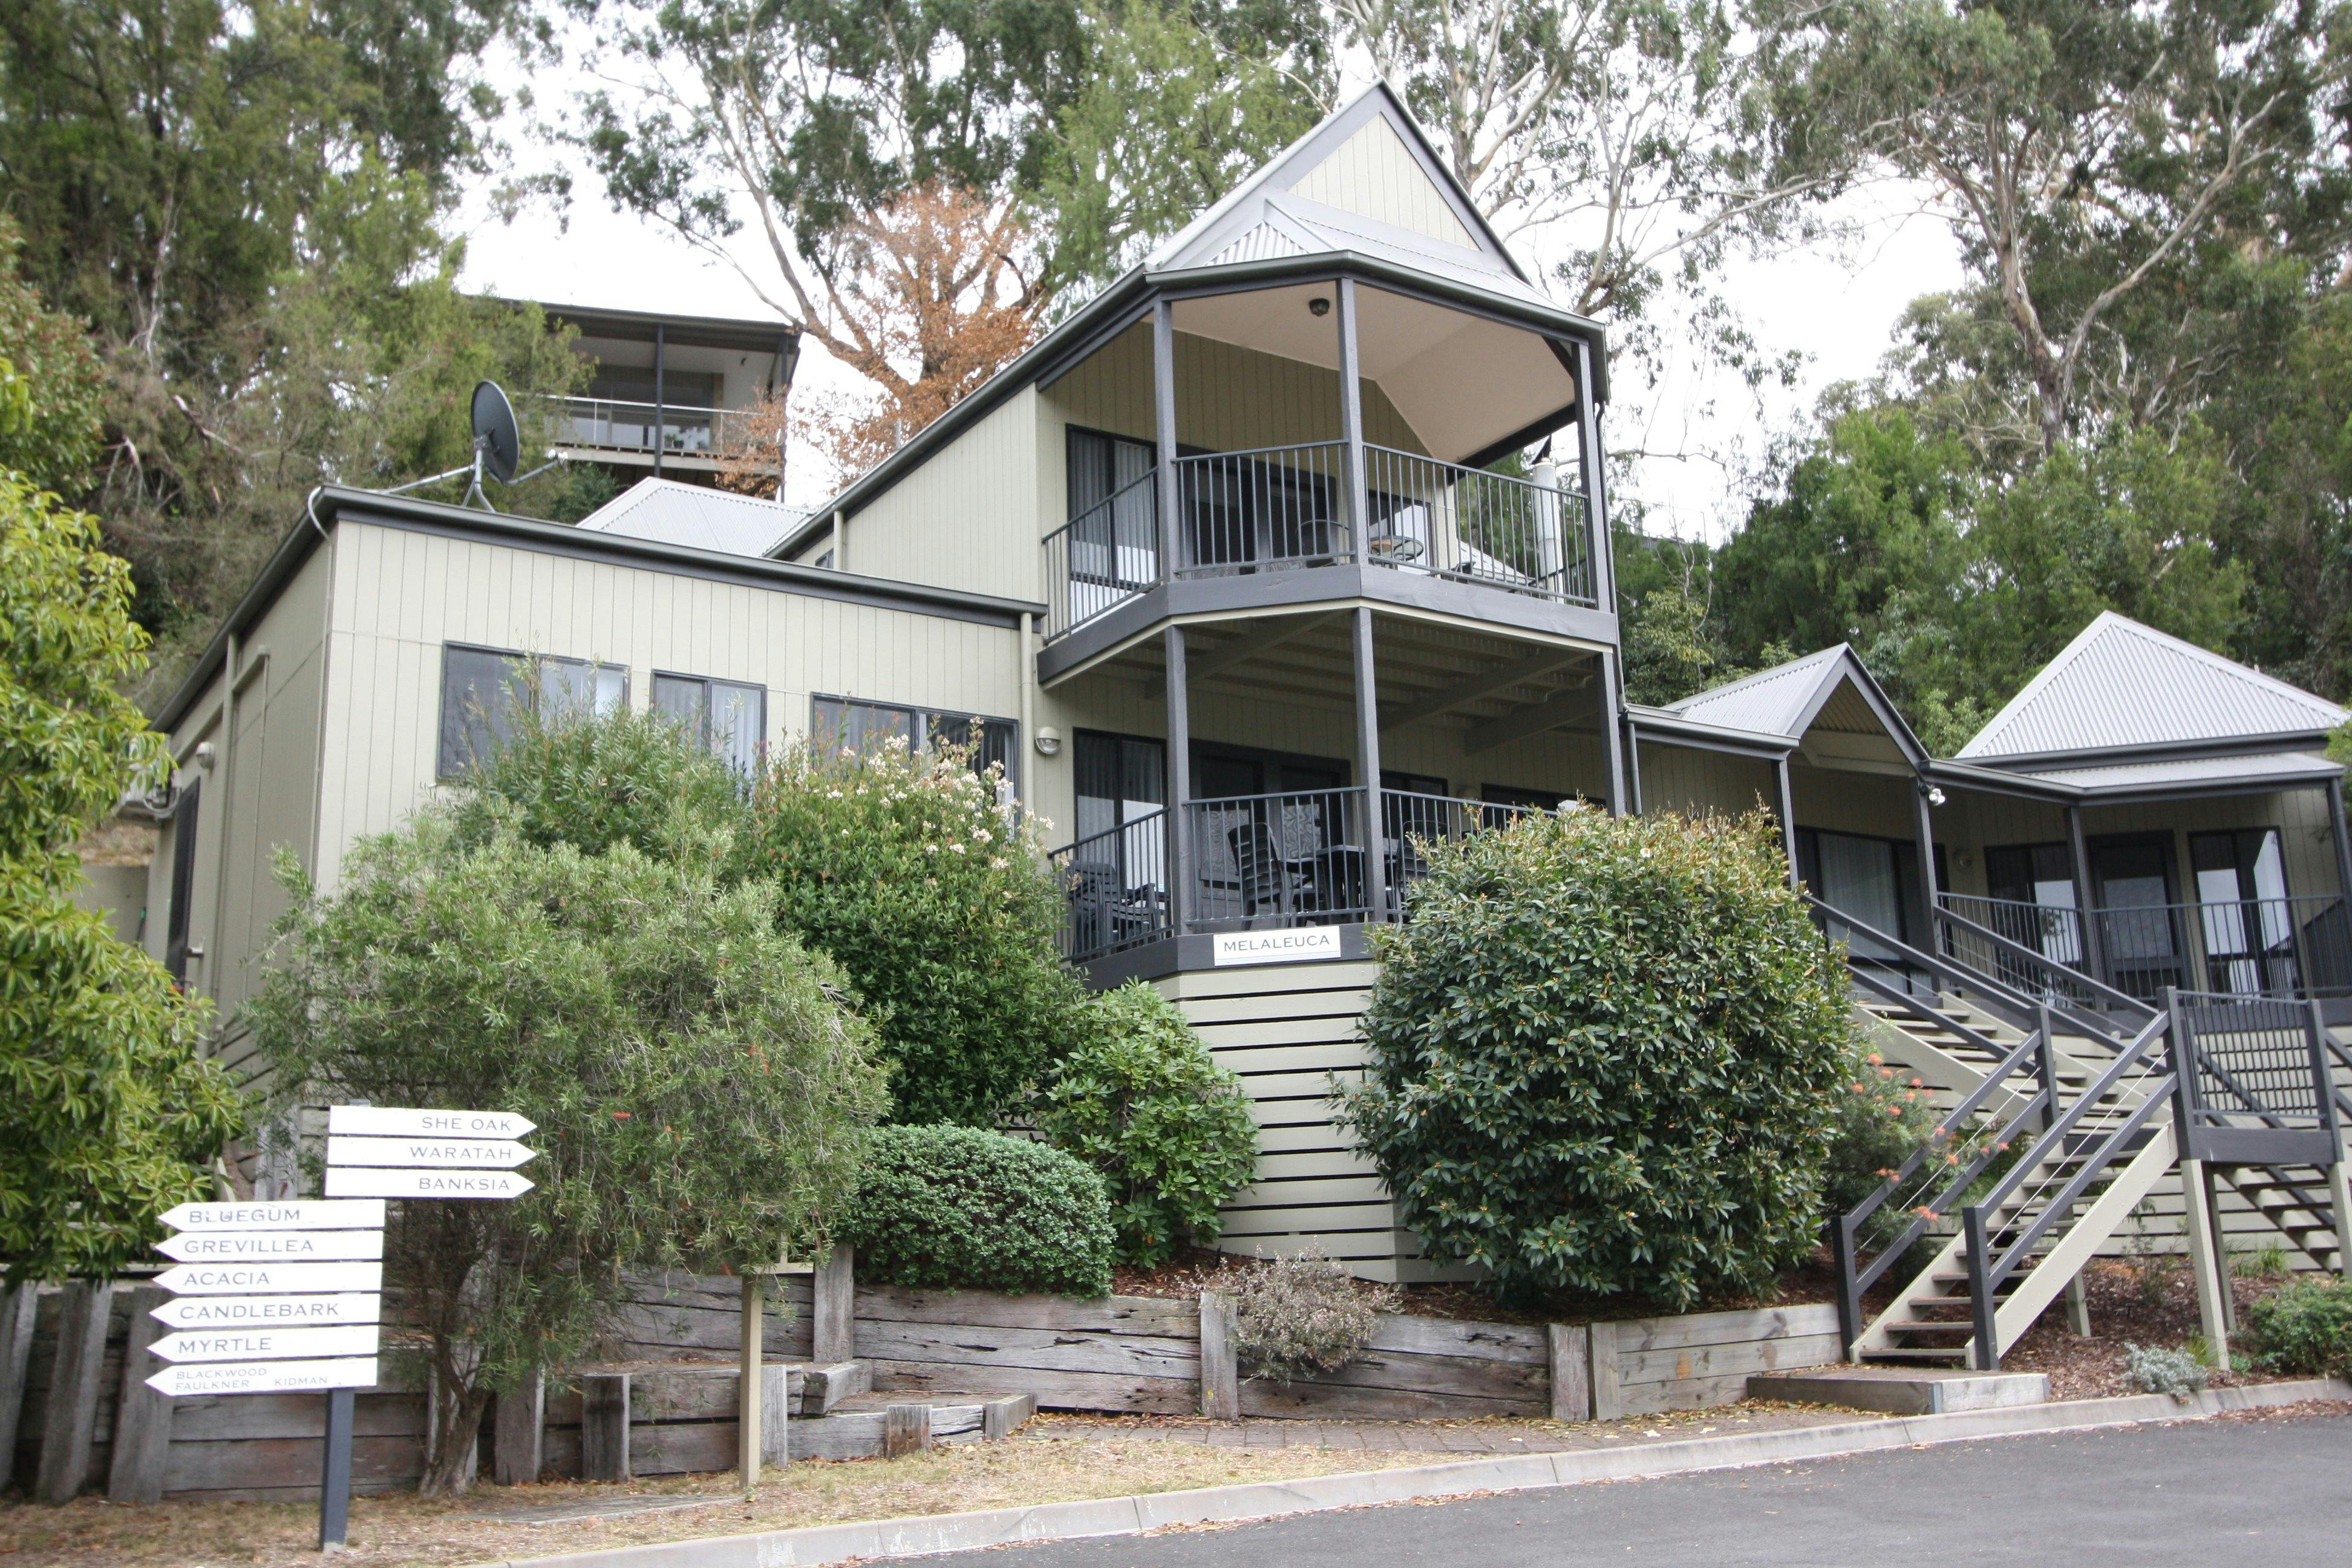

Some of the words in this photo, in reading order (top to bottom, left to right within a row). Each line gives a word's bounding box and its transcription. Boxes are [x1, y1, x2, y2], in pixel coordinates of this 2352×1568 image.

[1224, 935, 1330, 952] MELALEUCA
[422, 1117, 463, 1131] SHE
[471, 1118, 512, 1131] OAK
[410, 1147, 511, 1160] WARATAH
[418, 1177, 510, 1191] BANKSIA
[189, 1209, 301, 1223] BLUEGUM
[184, 1239, 314, 1253] GREVILLEA
[183, 1272, 270, 1286] ACACIA
[179, 1302, 340, 1320] CANDLEBARK
[178, 1337, 272, 1353] MYRTLE
[176, 1368, 267, 1379] BLACKWOOD
[175, 1379, 250, 1391] FAULKNER
[274, 1376, 328, 1386] KIDMAN
